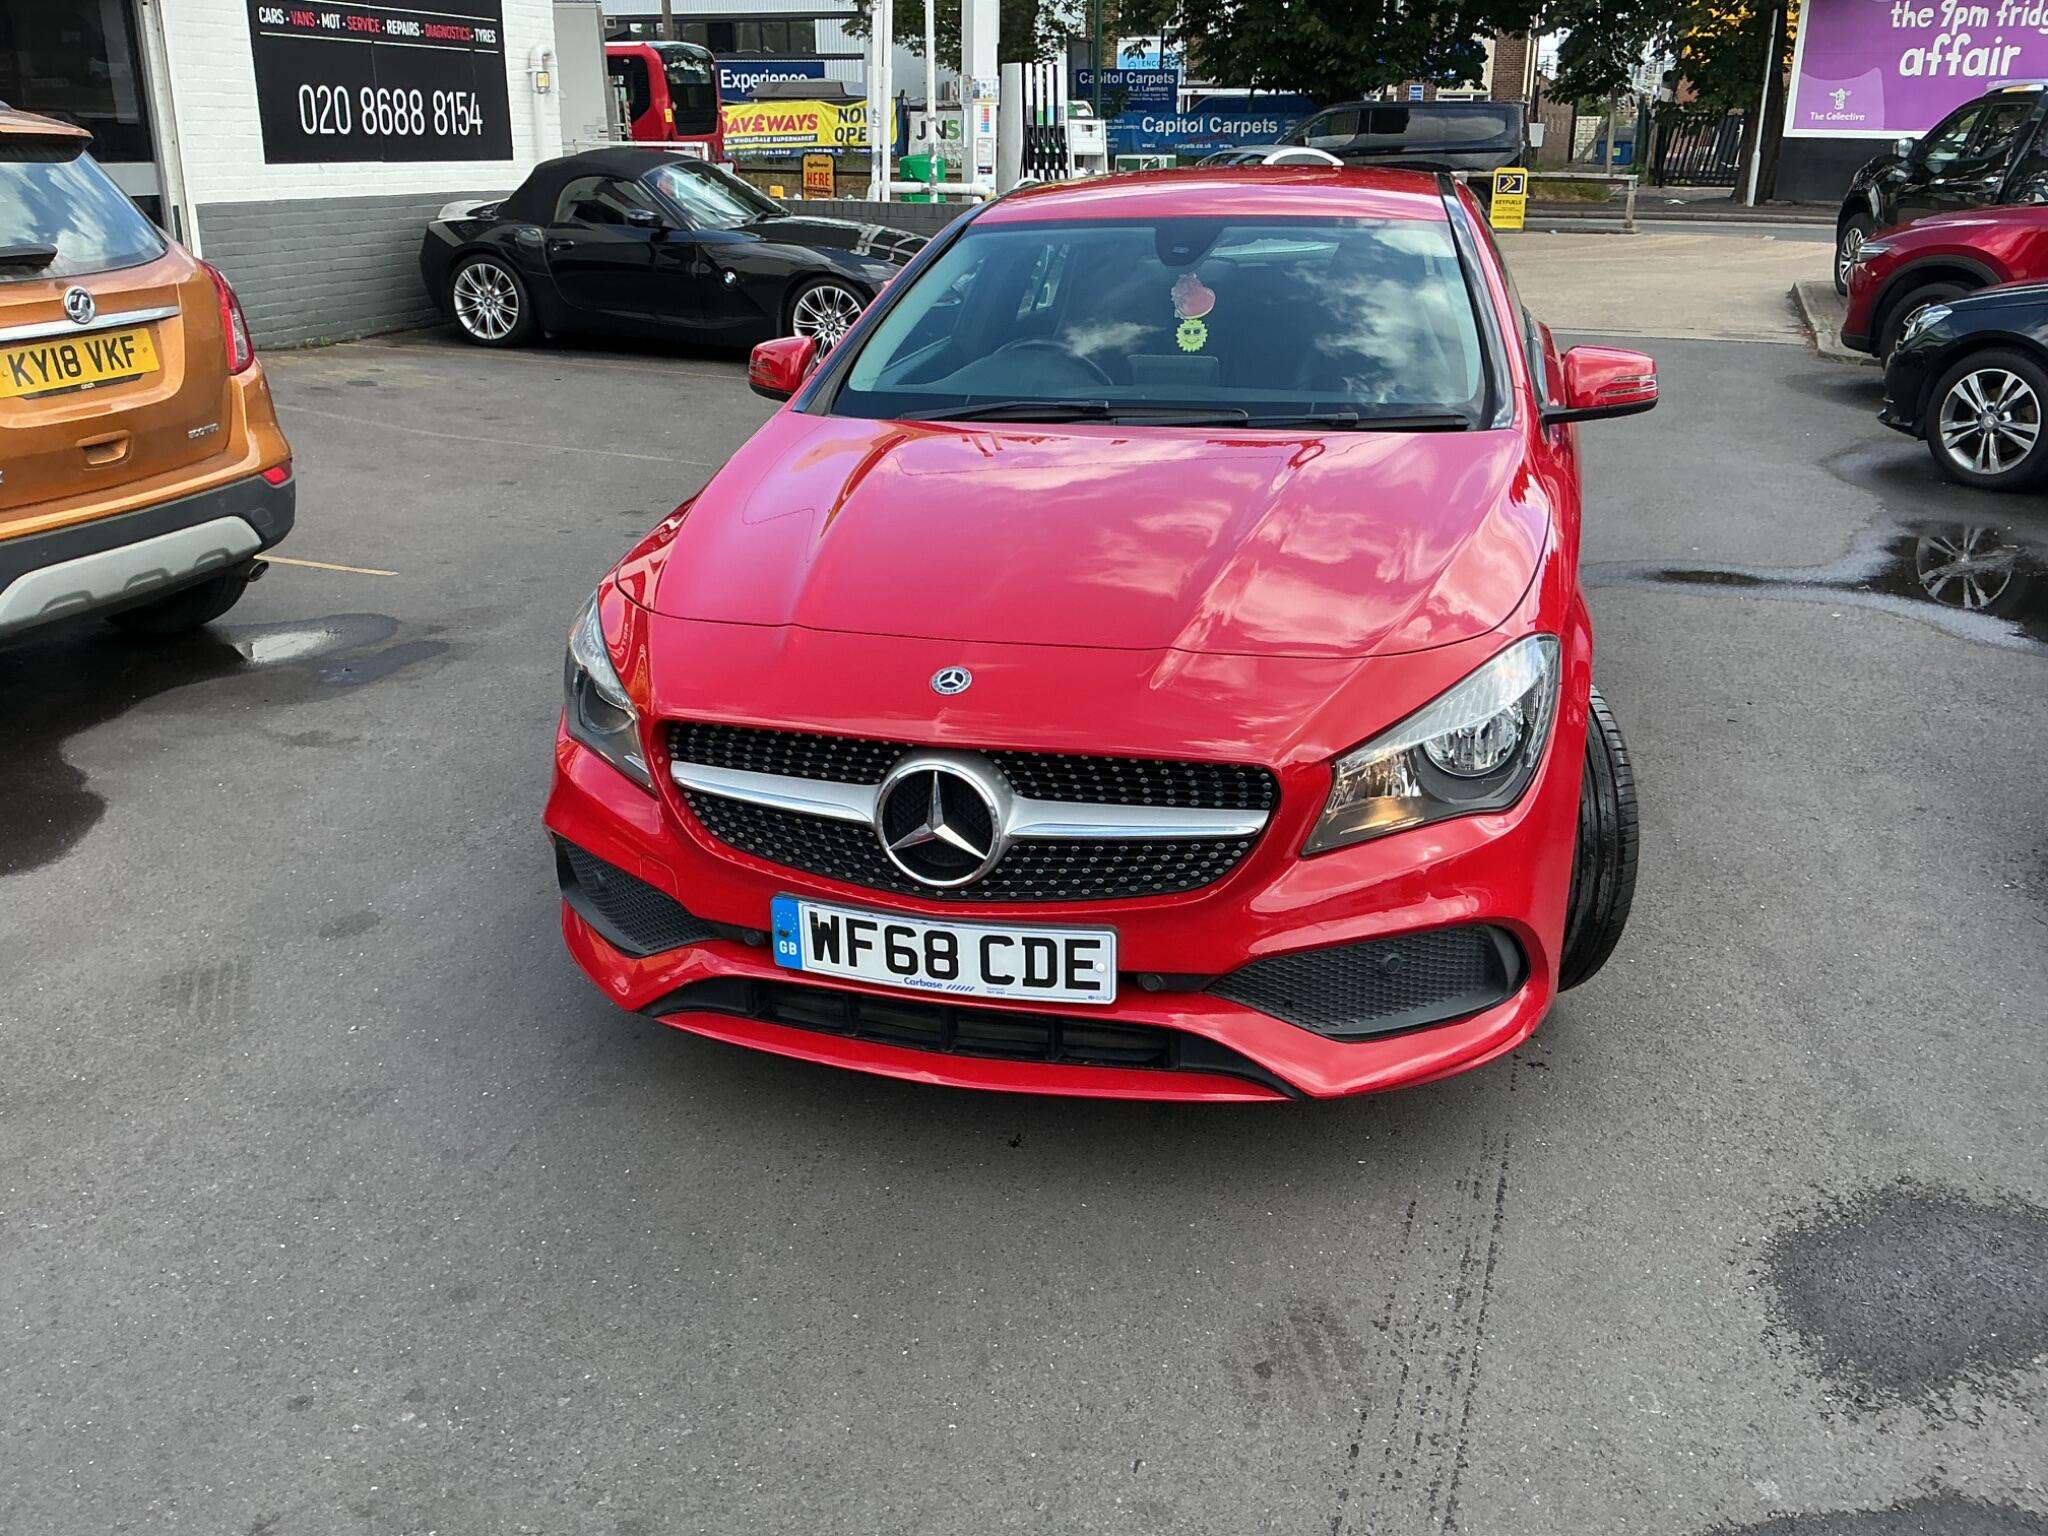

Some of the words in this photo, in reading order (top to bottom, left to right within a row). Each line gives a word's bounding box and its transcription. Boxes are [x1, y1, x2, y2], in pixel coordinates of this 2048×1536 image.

[259, 6, 284, 25] CARS
[290, 11, 315, 28] VANS
[321, 13, 340, 29] MOT
[347, 16, 380, 34] SERVICE
[386, 19, 420, 36] REPAIRS
[425, 22, 471, 41] DIAGNOSTICS
[474, 28, 496, 43] TYRES
[1891, 0, 1934, 28] the
[1940, 0, 1990, 35] 9pm
[1899, 33, 2022, 77] affair
[1126, 72, 1175, 86] Carpets
[298, 84, 351, 135] 020
[360, 87, 425, 136] 8688
[433, 90, 483, 136] 8154
[838, 107, 867, 123] NO
[1810, 111, 1824, 121] The
[1826, 111, 1866, 121] Collective
[835, 126, 867, 142] OPE
[1141, 115, 1204, 137] Capitol
[1209, 115, 1278, 137] Carpets
[807, 172, 830, 186] HERE
[7, 344, 82, 388] KY18
[84, 335, 135, 373] VKF
[779, 940, 797, 956] GB
[809, 911, 960, 981] WF68
[979, 934, 1101, 991] CDE
[903, 976, 943, 990] Carbase
